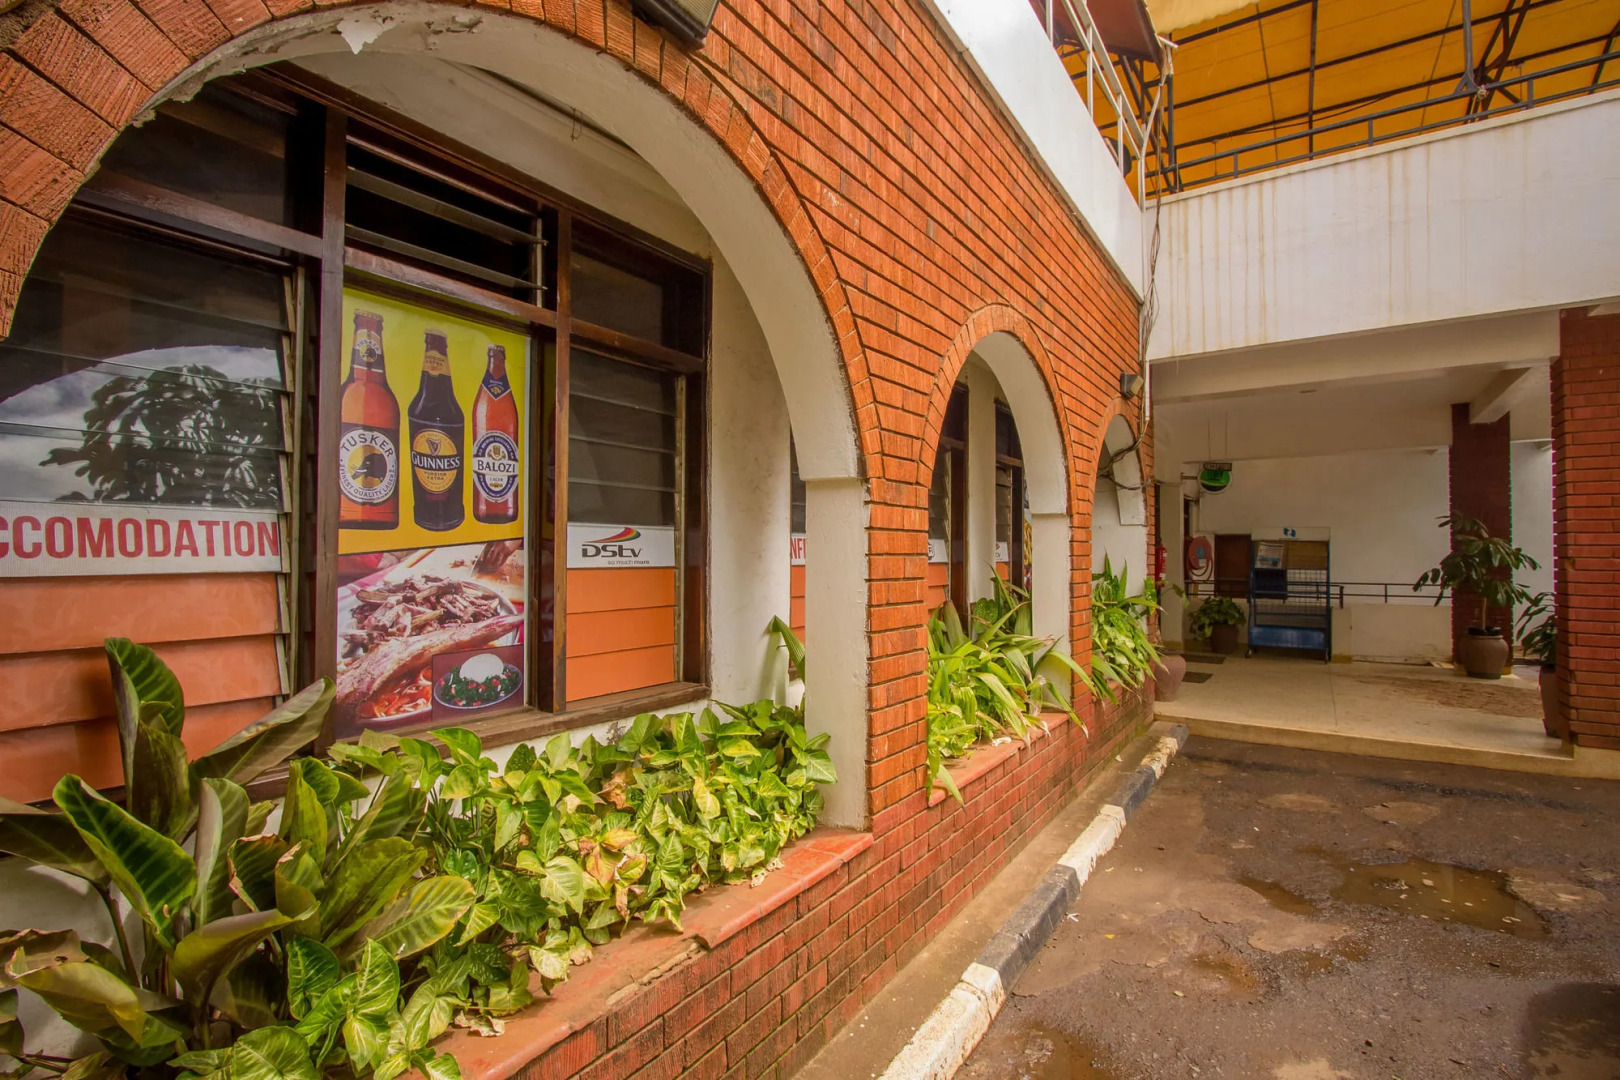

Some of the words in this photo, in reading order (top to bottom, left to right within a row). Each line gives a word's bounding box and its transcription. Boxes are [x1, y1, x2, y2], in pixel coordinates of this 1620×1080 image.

[356, 339, 380, 351] TUSKER
[341, 433, 394, 458] TUSKER
[411, 451, 461, 470] GUINNESS
[477, 459, 516, 473] BALOZI
[353, 488, 383, 498] QUALITY
[581, 543, 642, 558] DStv
